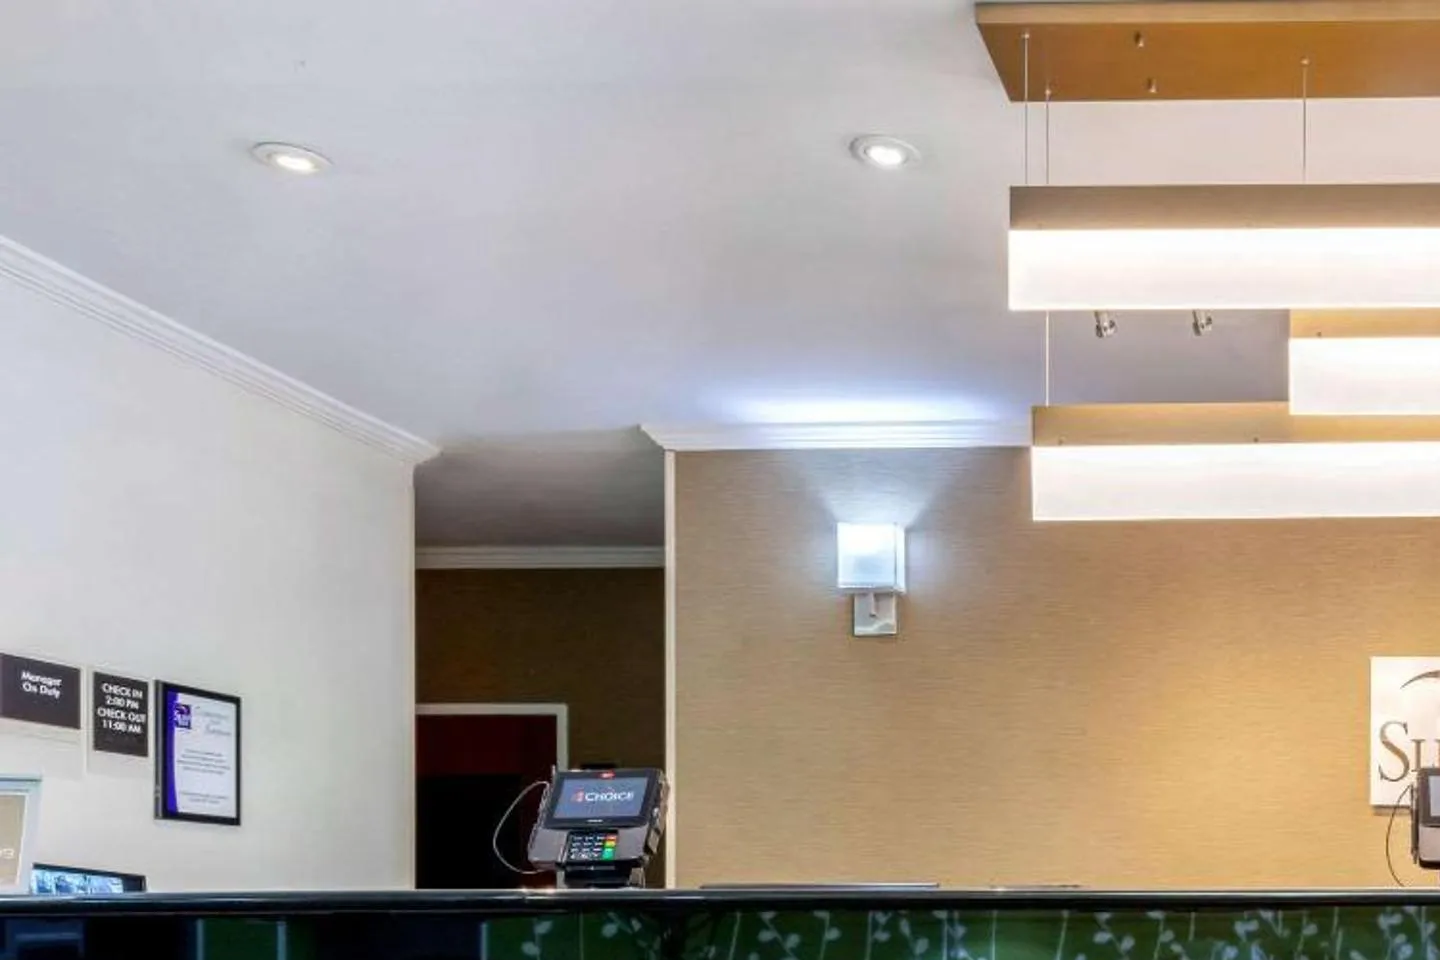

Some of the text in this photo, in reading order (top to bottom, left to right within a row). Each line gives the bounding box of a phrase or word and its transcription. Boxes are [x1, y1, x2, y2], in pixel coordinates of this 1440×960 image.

[21, 671, 62, 687] Manager
[22, 682, 61, 699] On Duty
[102, 682, 143, 700] CHECK IN
[126, 699, 139, 710] PM
[97, 707, 147, 724] CHECK OUT
[102, 719, 142, 735] 11:00 AM
[585, 791, 634, 803] CHOICE
